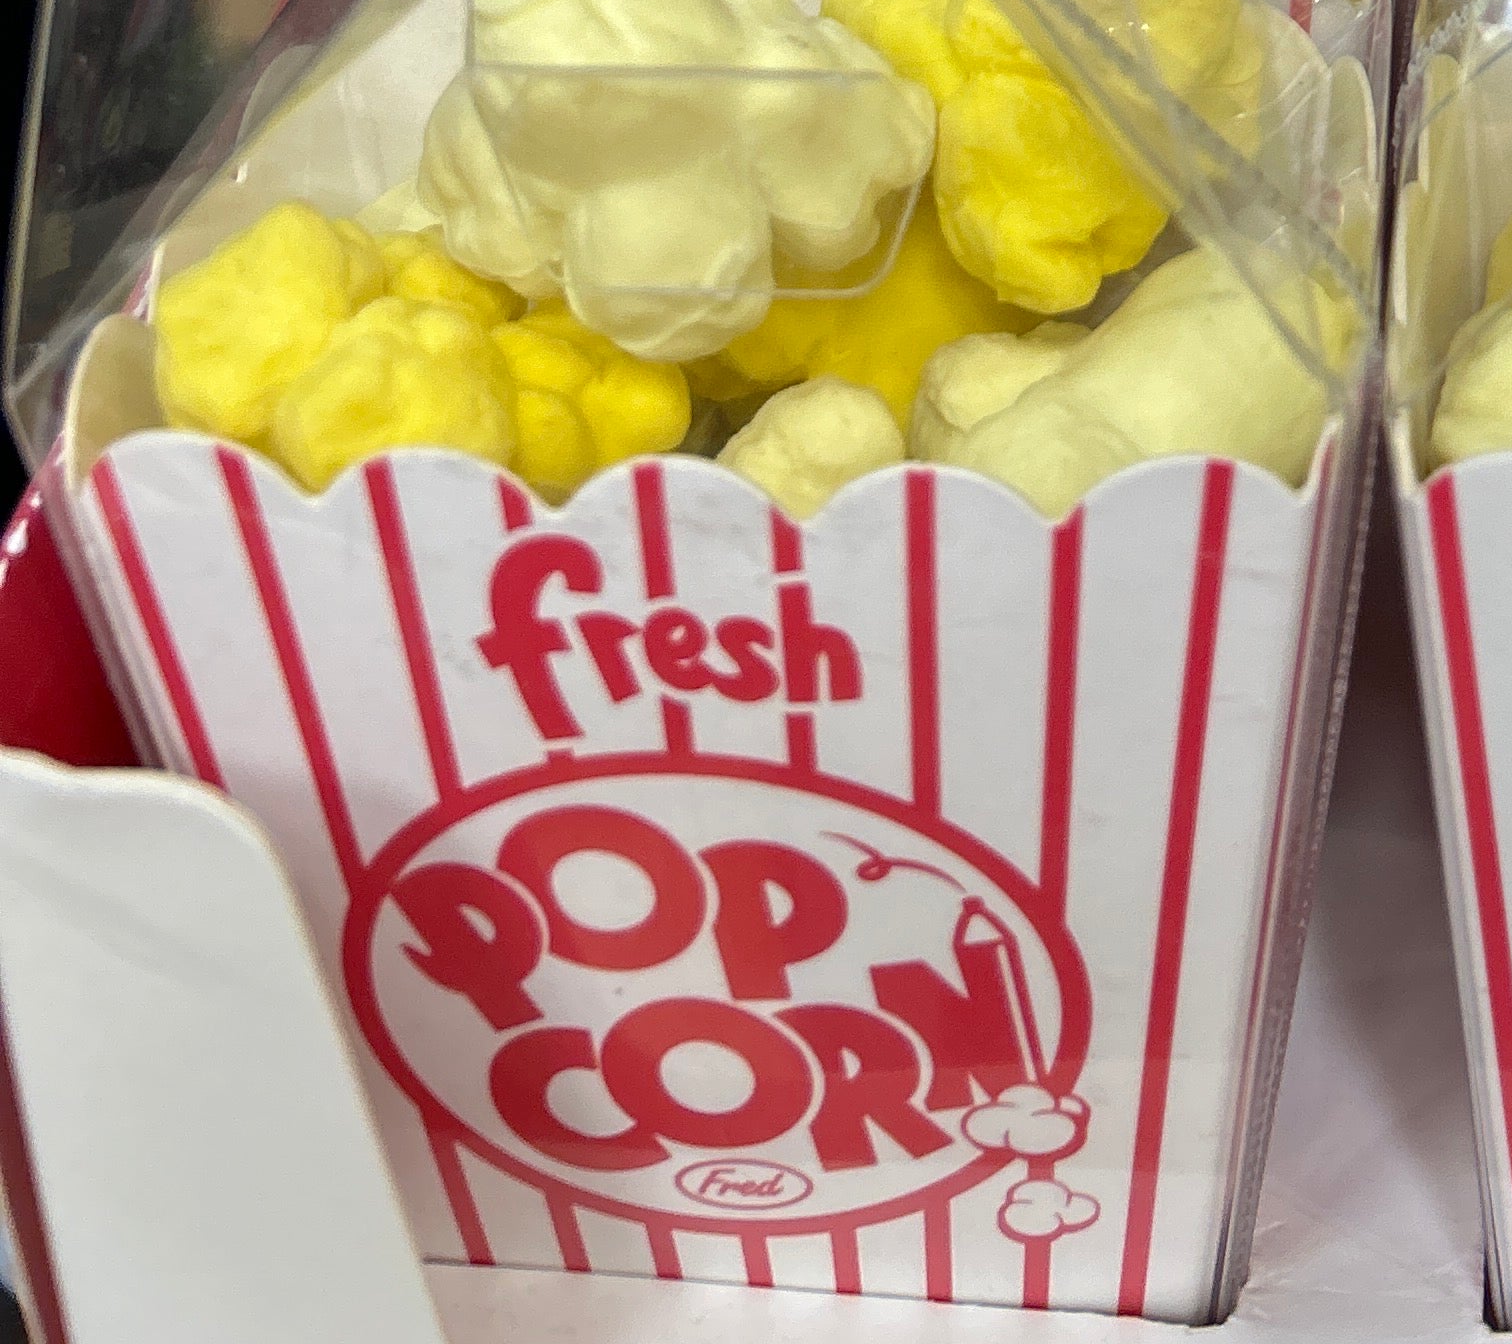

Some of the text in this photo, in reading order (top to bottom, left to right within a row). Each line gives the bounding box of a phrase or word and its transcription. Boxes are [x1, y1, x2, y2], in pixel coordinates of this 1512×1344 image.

[474, 533, 864, 742] fresh
[391, 804, 849, 1031] POP
[489, 938, 1035, 1171] CORN
[696, 1166, 788, 1201] Fred
